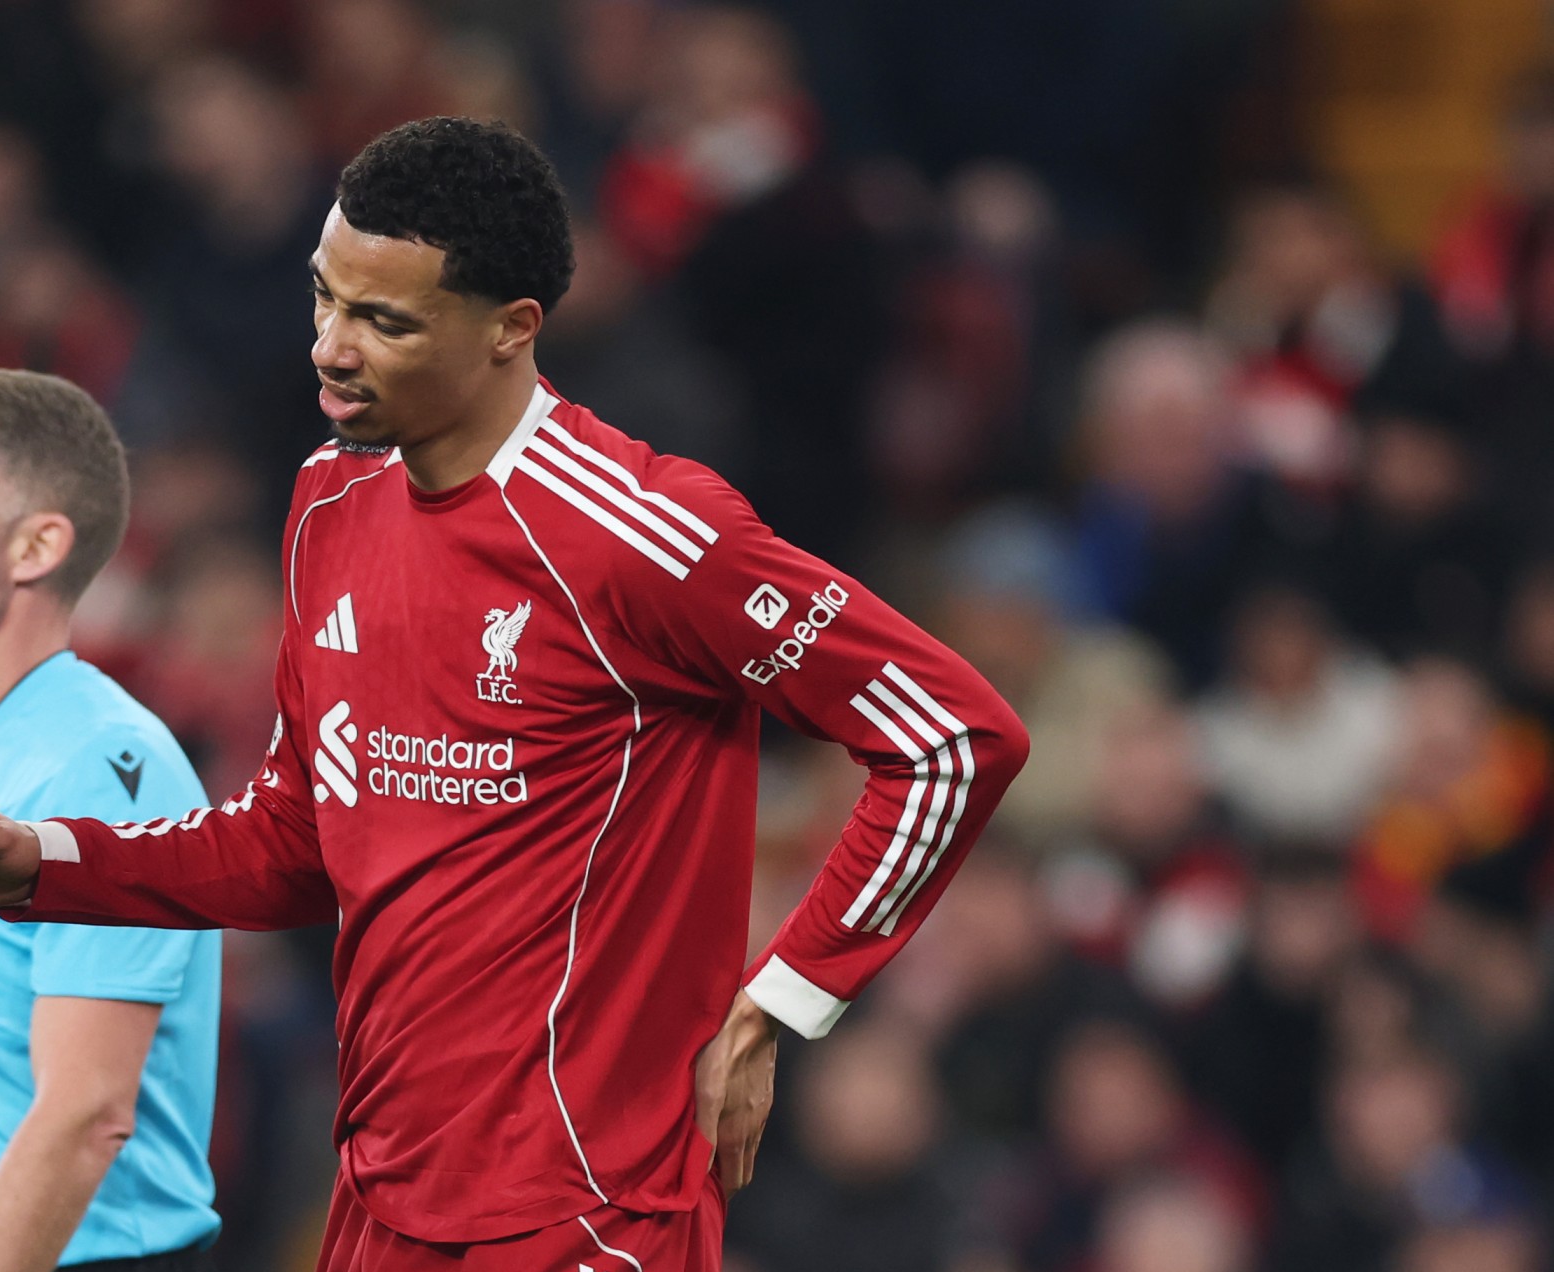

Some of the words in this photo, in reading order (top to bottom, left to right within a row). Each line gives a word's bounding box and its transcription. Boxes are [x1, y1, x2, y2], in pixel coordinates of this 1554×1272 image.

[740, 580, 850, 686] Expedia
[475, 679, 523, 705] L.F.C.
[367, 725, 514, 771] standard
[368, 762, 528, 805] chartered
